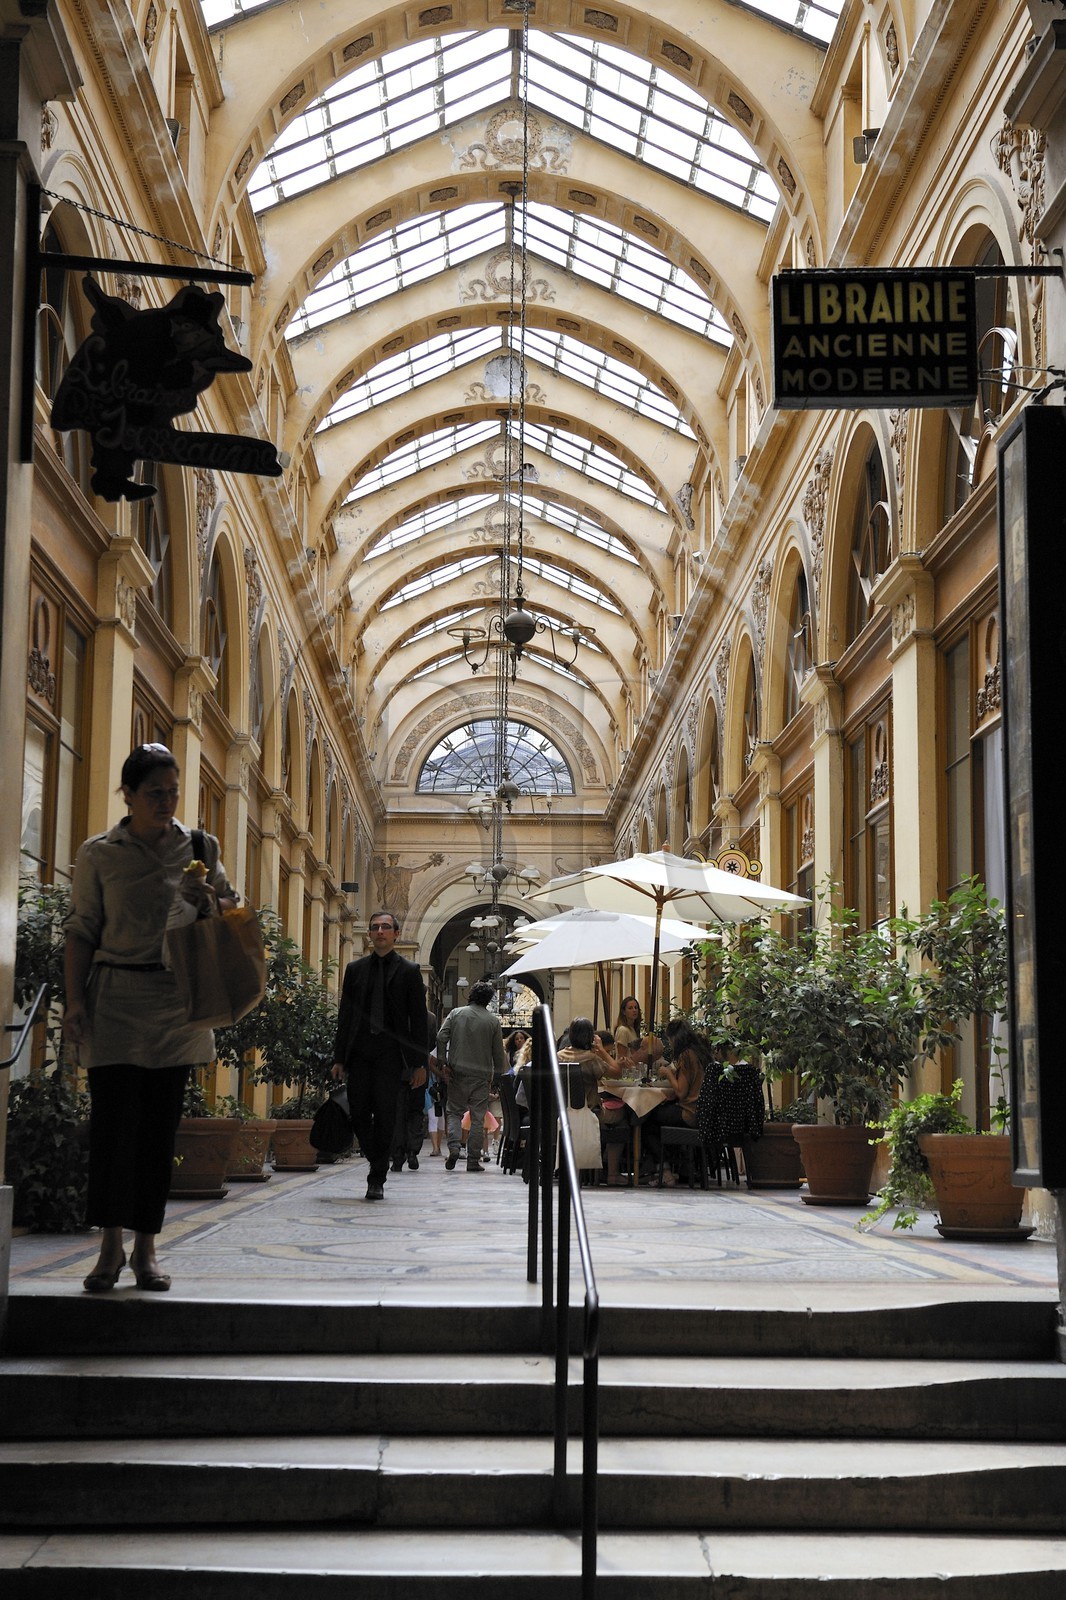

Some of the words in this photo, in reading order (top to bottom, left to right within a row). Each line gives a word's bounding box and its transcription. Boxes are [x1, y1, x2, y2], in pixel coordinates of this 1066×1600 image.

[781, 280, 967, 325] LIBRAIRIE
[782, 332, 967, 358] ANCIENNE
[782, 366, 969, 391] MODERNE
